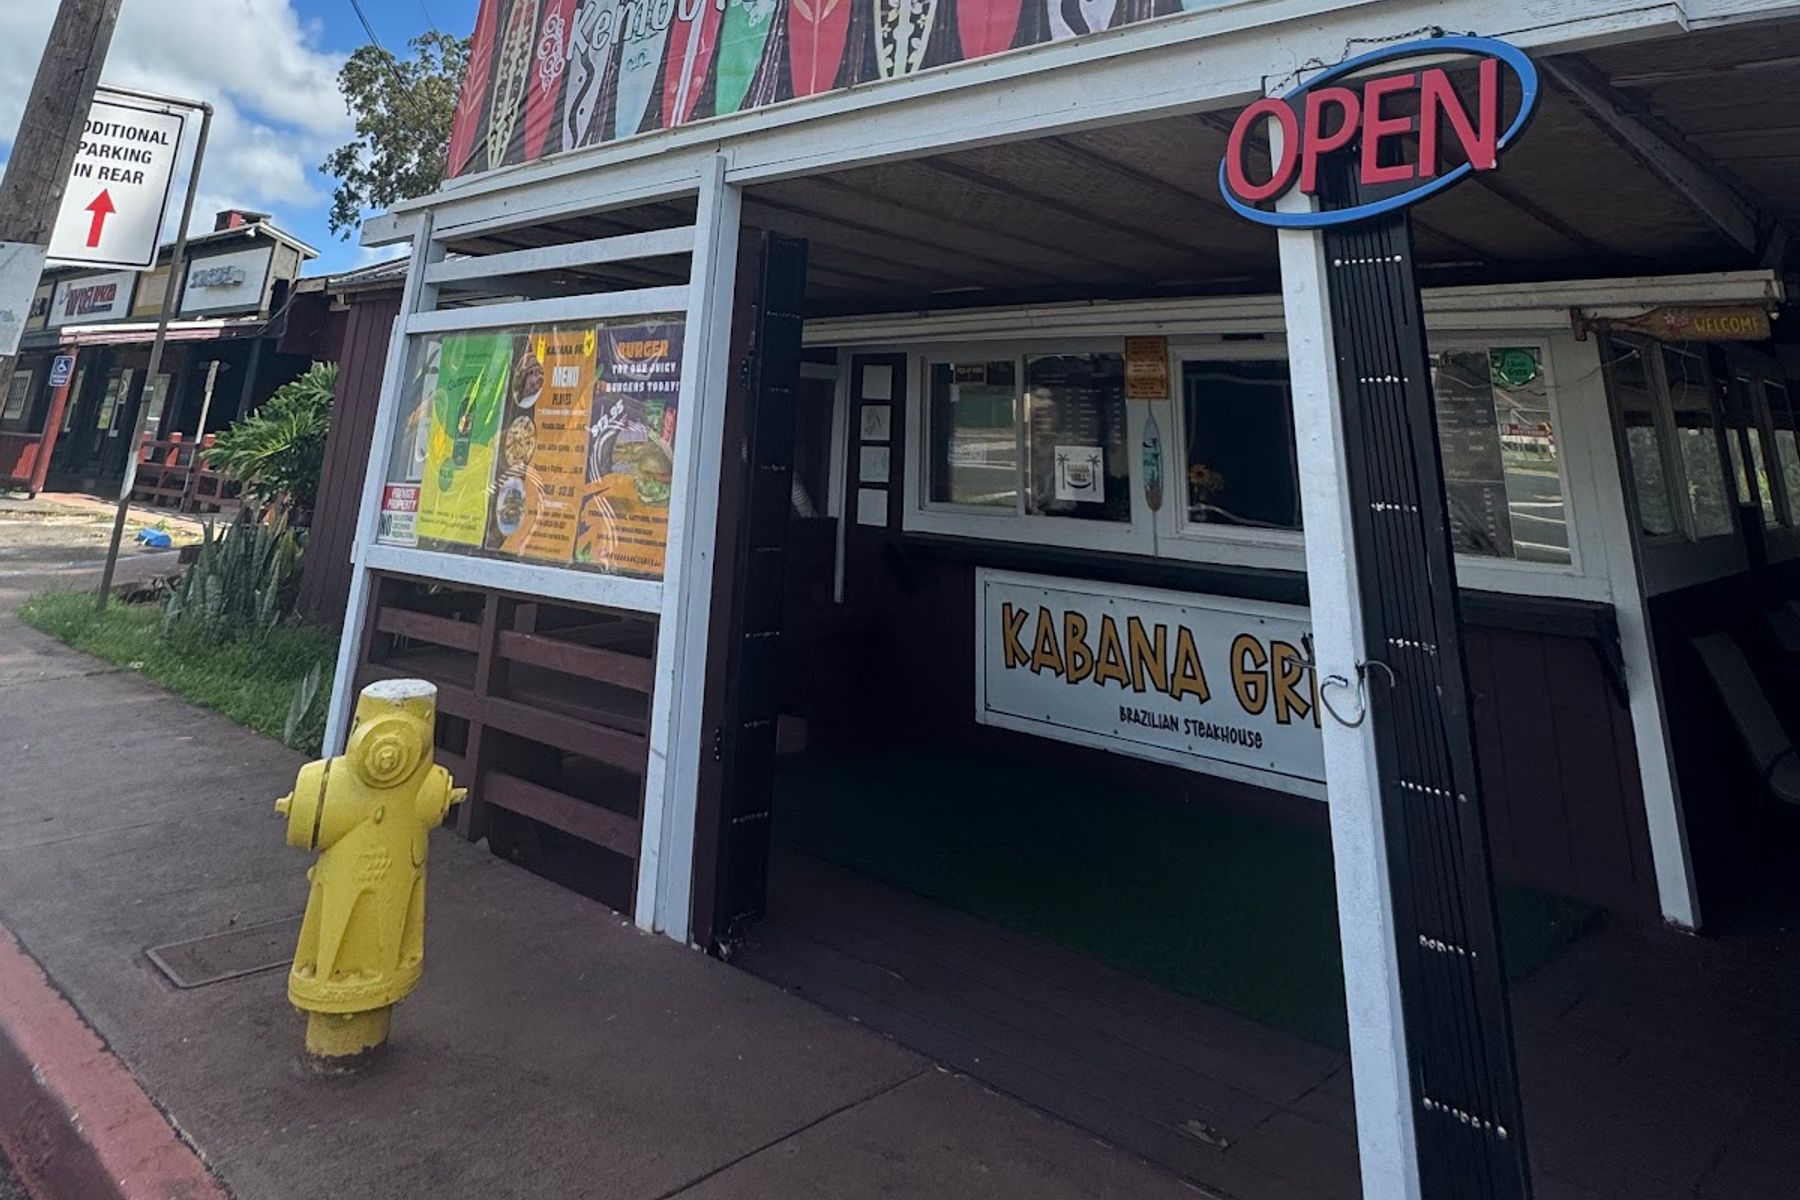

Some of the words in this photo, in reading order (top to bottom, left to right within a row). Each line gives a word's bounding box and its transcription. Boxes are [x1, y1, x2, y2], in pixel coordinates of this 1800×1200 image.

[84, 120, 169, 146] DDITIONAL
[1226, 58, 1498, 201] OPEN
[77, 141, 153, 164] PARKING
[73, 162, 93, 178] IN
[97, 166, 144, 185] REAR
[617, 340, 669, 358] BURGER
[1001, 602, 1211, 704] KABANA
[1119, 705, 1179, 732] BRAZILIAN
